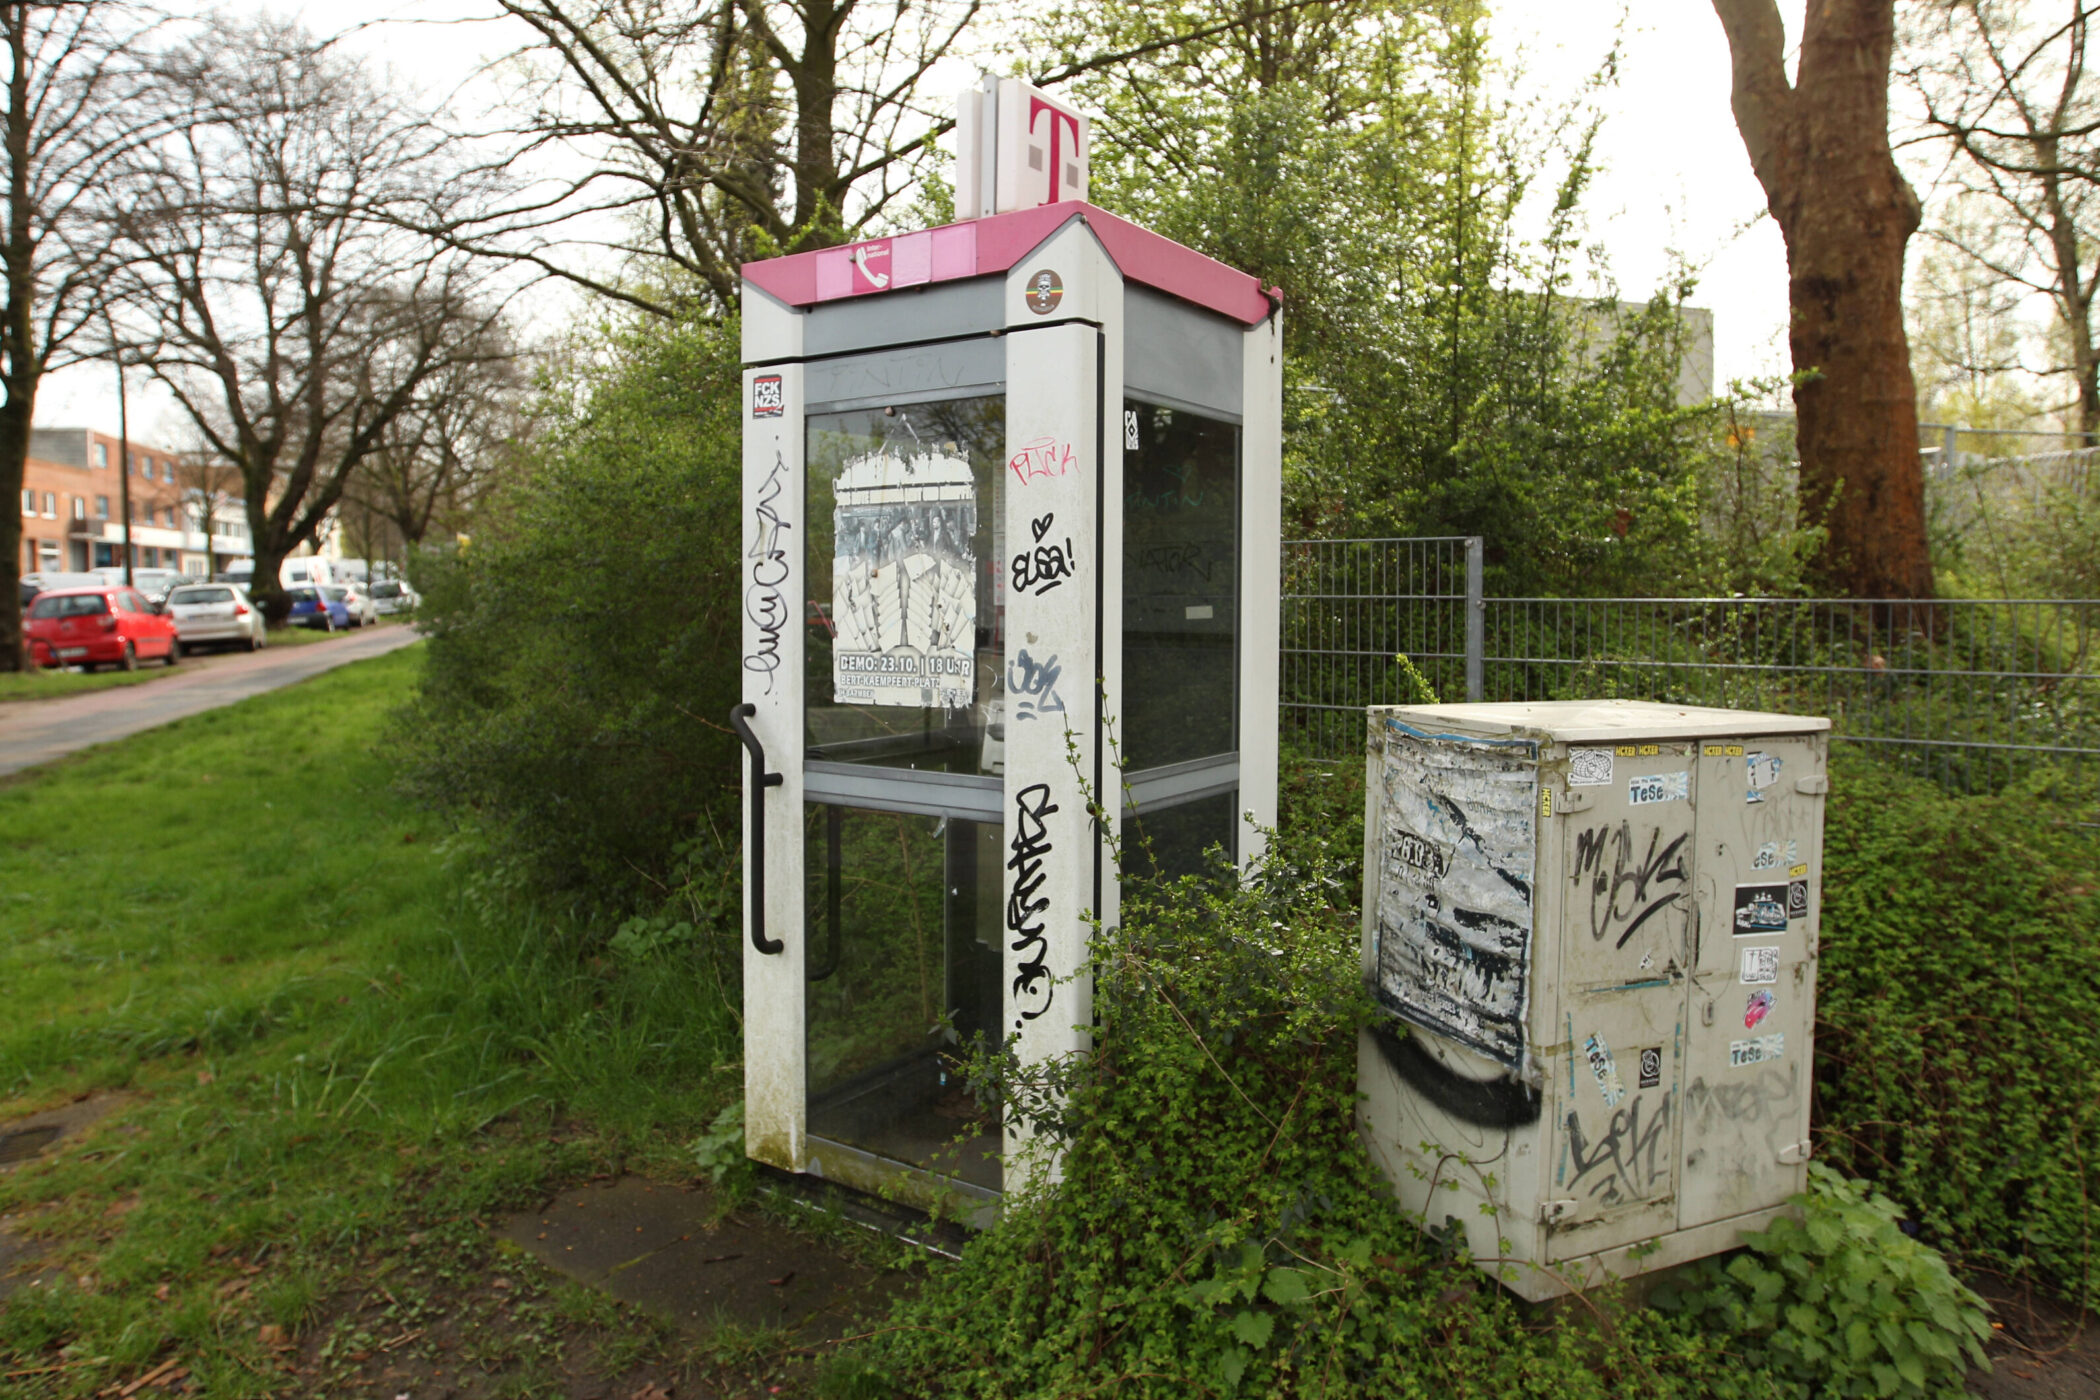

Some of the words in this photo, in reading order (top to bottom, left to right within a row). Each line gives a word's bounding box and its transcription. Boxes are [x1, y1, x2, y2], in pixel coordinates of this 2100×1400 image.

[1029, 95, 1079, 206] T
[755, 381, 780, 395] FCK
[755, 394, 780, 408] NZS
[840, 656, 877, 671] DEMO:
[880, 657, 917, 672] 23.10.
[929, 659, 943, 673] 18
